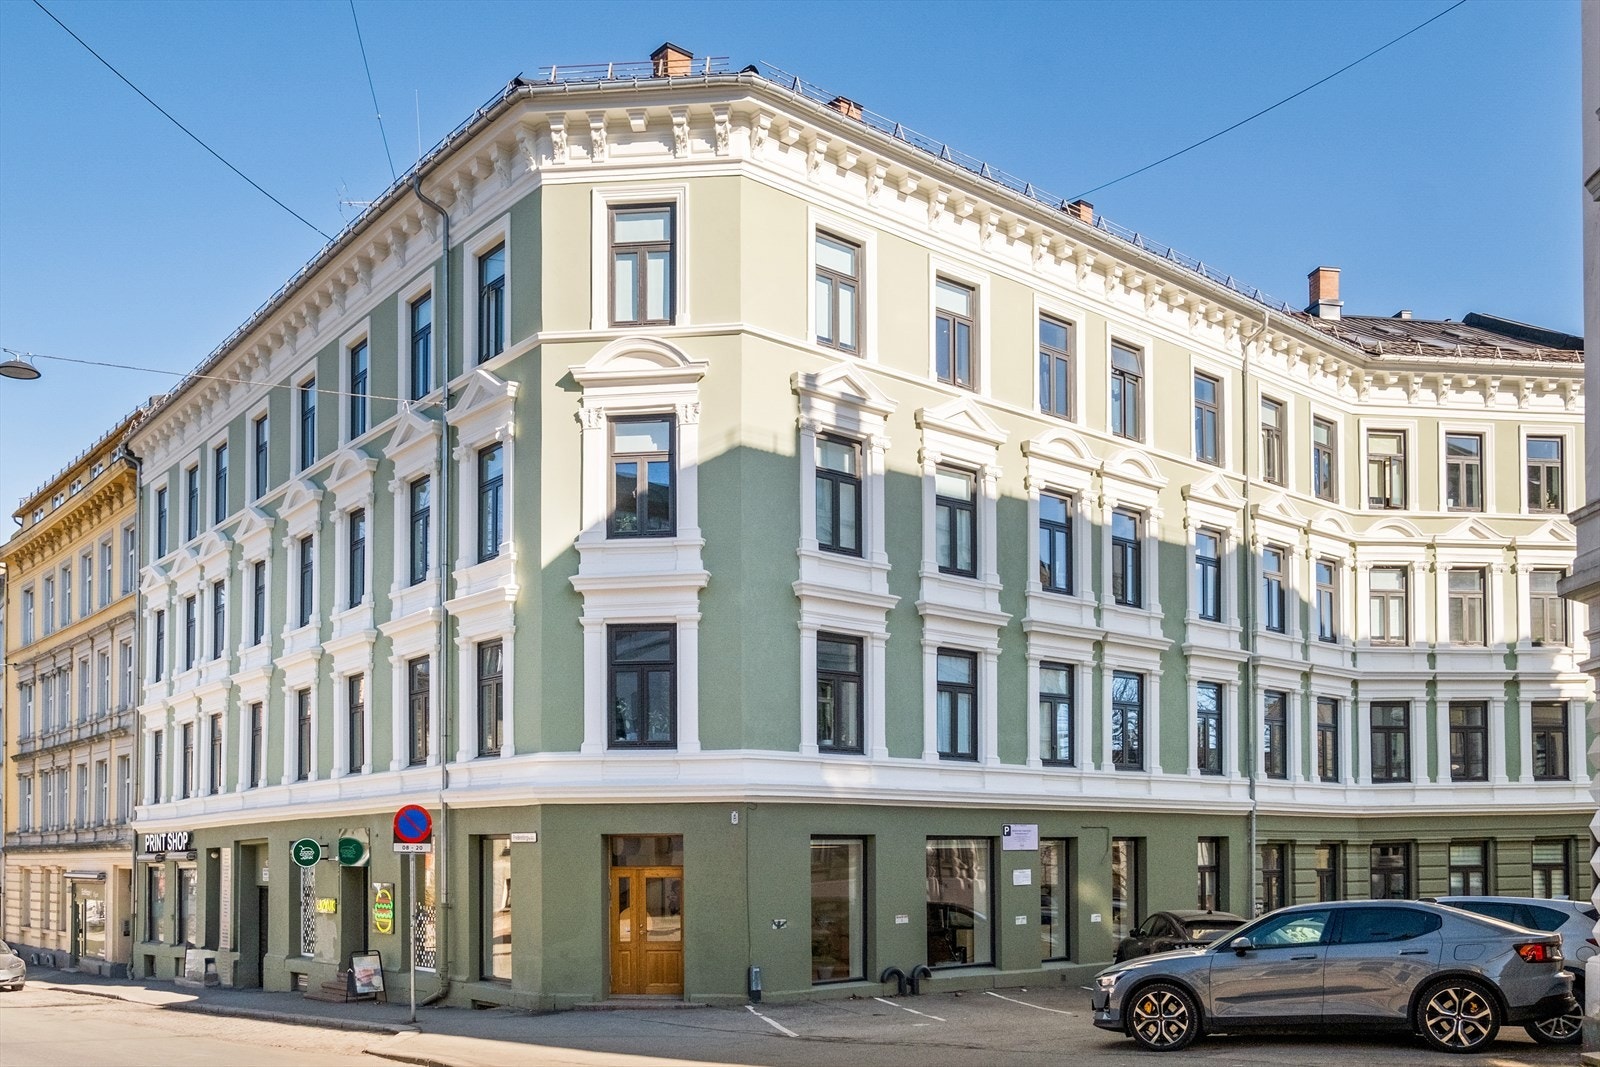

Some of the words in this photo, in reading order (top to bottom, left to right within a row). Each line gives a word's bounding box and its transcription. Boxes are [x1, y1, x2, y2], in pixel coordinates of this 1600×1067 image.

[1004, 826, 1010, 836] P
[145, 833, 166, 851] PRINT
[167, 831, 188, 850] SHOP
